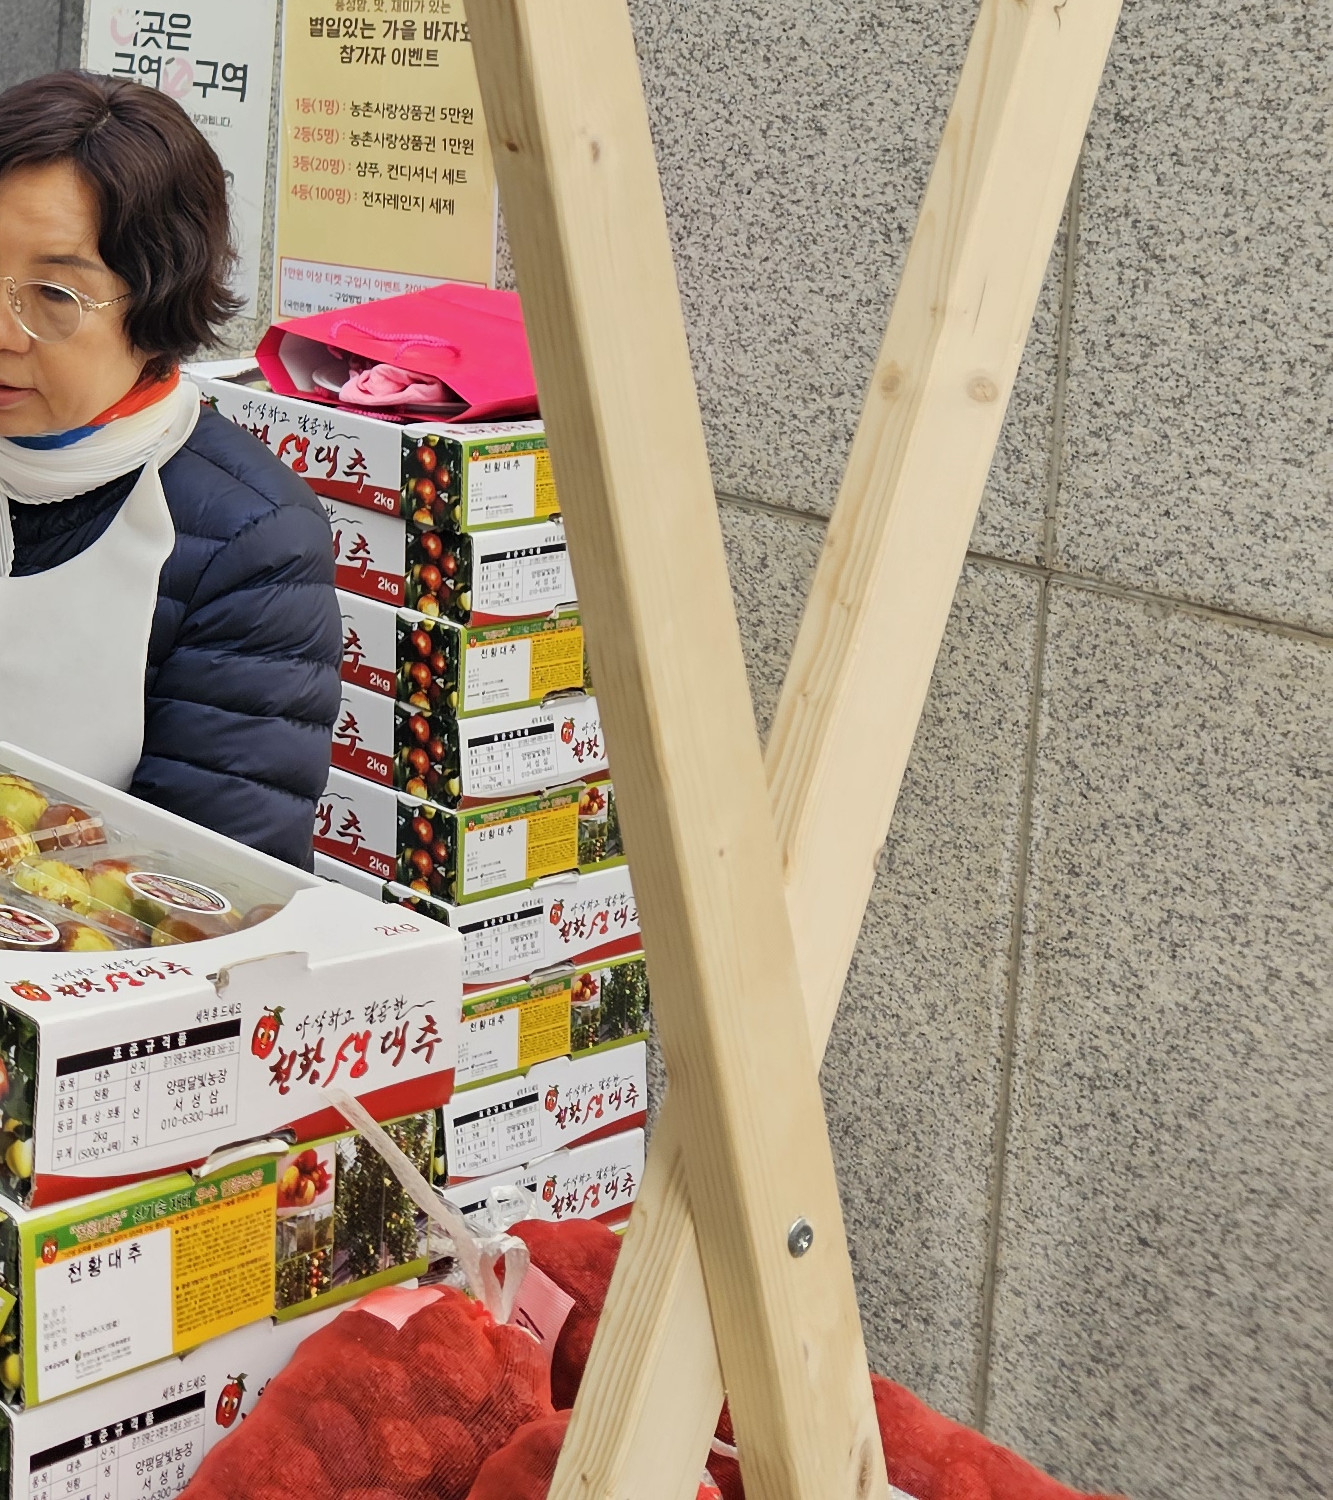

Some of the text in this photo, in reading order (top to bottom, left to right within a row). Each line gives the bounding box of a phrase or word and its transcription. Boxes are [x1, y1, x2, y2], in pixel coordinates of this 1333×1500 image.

[391, 0, 425, 13] 재미가
[429, 0, 451, 14] 있는
[309, 16, 376, 40] 별일있는
[382, 20, 417, 41] 가을
[340, 45, 439, 67] 참가자 이벤트
[193, 60, 248, 102] 구역
[295, 98, 339, 115] 1등(1명)
[349, 100, 435, 122] 농촌사랑상품권
[440, 107, 474, 125] 5만원
[293, 126, 339, 144] 2등(5명)
[349, 130, 435, 153] 농촌사랑상품권
[442, 138, 474, 156] 1만원
[292, 156, 345, 175] 3등(20명)
[356, 161, 382, 178] 샴푸,
[387, 164, 437, 184] 컨디셔너
[442, 169, 468, 185] 세트
[291, 184, 351, 204] 4등(100명)
[362, 191, 424, 212] 전자레인지
[429, 198, 455, 215] 세제
[283, 266, 303, 281] 1만원
[306, 269, 322, 282] 이상
[344, 275, 371, 290] 구입시
[374, 278, 401, 292] 이벤트
[242, 401, 290, 425] 아삭하고
[373, 491, 394, 510] 2kg
[378, 576, 399, 595] 2kg
[370, 672, 390, 691] 2kg
[367, 755, 388, 776] 2kg
[369, 855, 390, 876] 2kg
[373, 922, 421, 938] 2kg
[220, 1003, 242, 1018] 드세요
[295, 1008, 355, 1036] 아삭하고
[167, 1068, 227, 1096] 양평달빛농장
[161, 1105, 229, 1130] 010-6300-4441
[93, 1131, 108, 1143] 2kg
[186, 1375, 207, 1392] 드세요
[135, 1441, 193, 1476] 양평달빛농장
